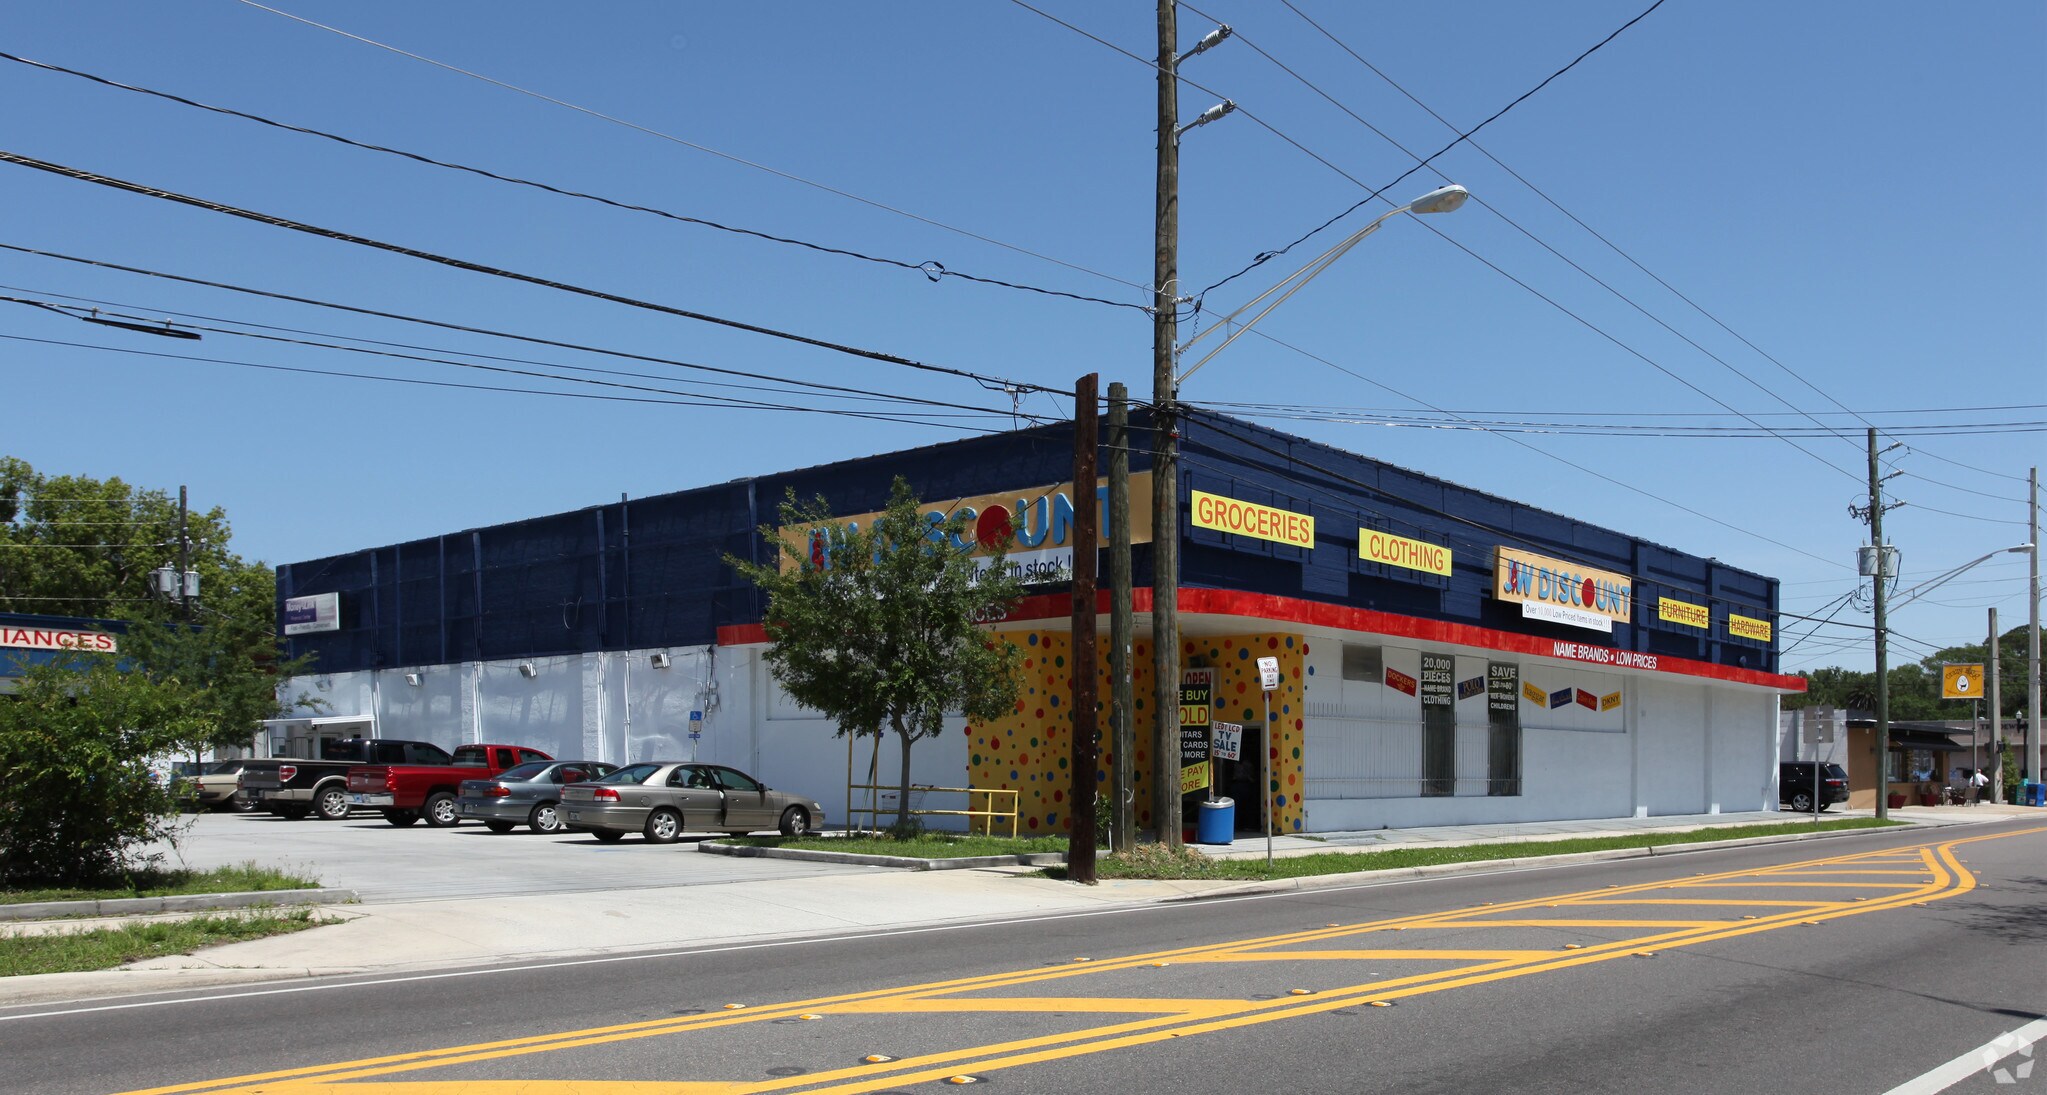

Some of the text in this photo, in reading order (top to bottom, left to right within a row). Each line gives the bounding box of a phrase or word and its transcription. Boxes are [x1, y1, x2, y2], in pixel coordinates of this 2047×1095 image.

[1198, 496, 1310, 544] GROCERIES
[1369, 534, 1444, 571] CLOTHING
[1538, 566, 1631, 615] DISCOUNT
[1525, 603, 1537, 614] Over
[1661, 601, 1706, 625] FURNITURE
[1731, 618, 1769, 639] HARDWARE
[1553, 641, 1657, 669] NAME BRANDS LOW PRICES
[1423, 657, 1451, 671] 20,000
[1185, 671, 1212, 684] OPEN
[1423, 671, 1451, 683] PIECES
[1491, 665, 1516, 678] SAVE
[1387, 670, 1415, 688] DOCKERS
[1463, 679, 1480, 693] POLO
[1423, 684, 1437, 692] NAME
[1186, 690, 1208, 701] BUY
[1423, 695, 1451, 705] CLOTHING
[1602, 694, 1619, 706] DKNY
[1179, 706, 1208, 725] OLD
[1180, 730, 1202, 739] ITARS
[1218, 730, 1232, 740] TV
[1183, 741, 1209, 749] CARDS
[1213, 738, 1237, 752] SALE
[1184, 750, 1206, 759] MORE
[1187, 764, 1205, 779] PAY
[1181, 778, 1201, 792] ORE
